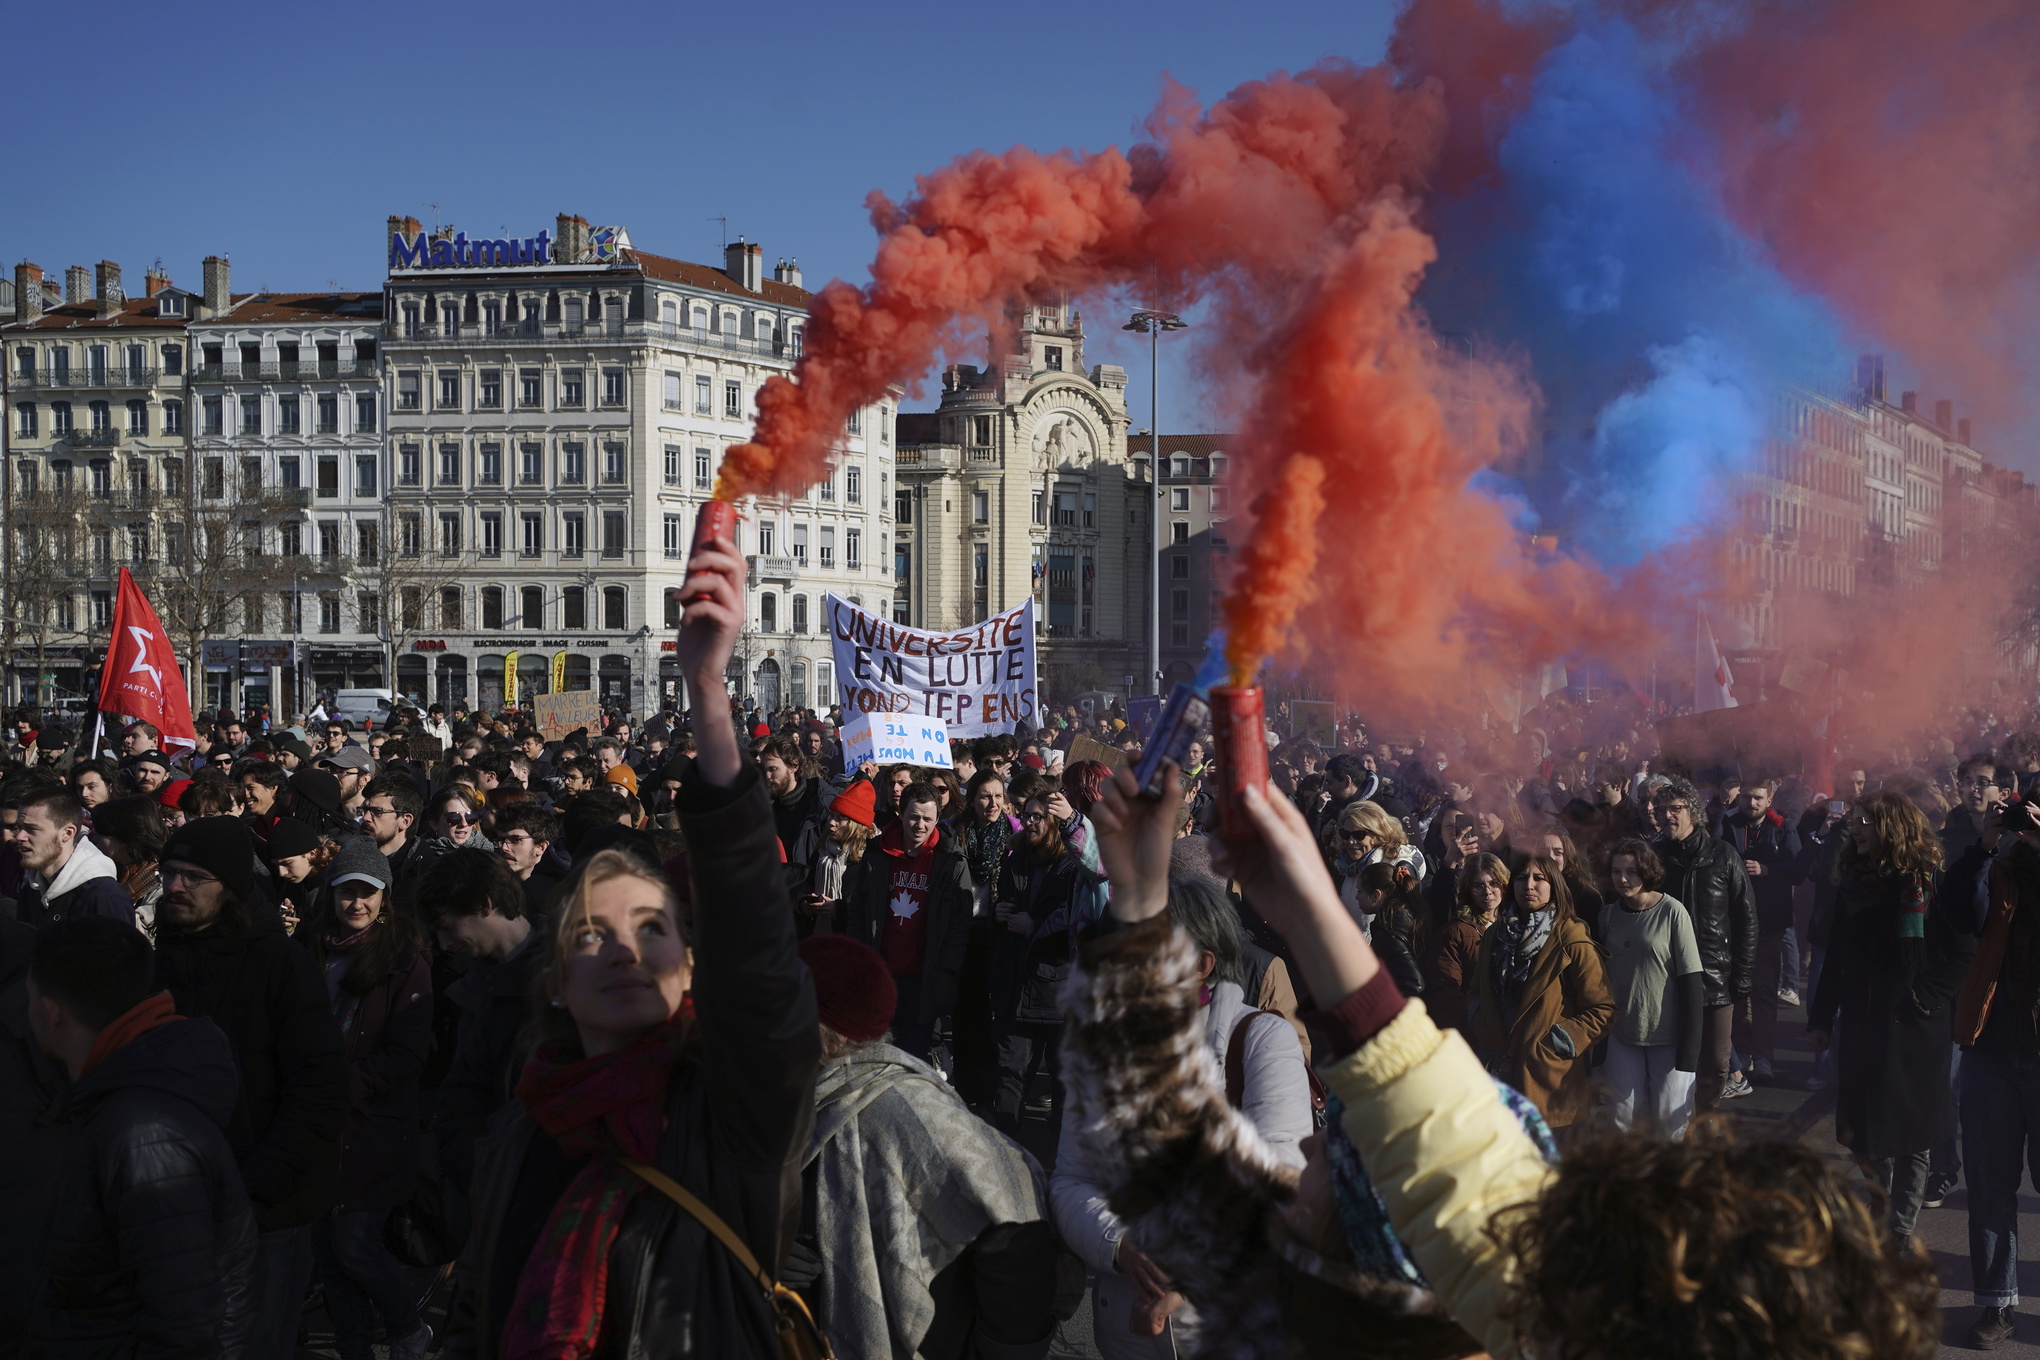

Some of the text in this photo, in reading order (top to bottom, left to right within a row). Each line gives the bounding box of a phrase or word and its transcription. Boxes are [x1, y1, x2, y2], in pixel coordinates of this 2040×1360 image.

[390, 229, 554, 268] Matmut
[834, 603, 1024, 656] UNIVERSITE
[415, 640, 447, 650] MDA
[660, 641, 677, 652] MD
[854, 646, 1024, 687] EN LUTTE
[123, 682, 148, 694] PARTI
[537, 692, 582, 712] MARRE
[585, 691, 599, 705] DE
[982, 689, 1035, 724] ENS
[885, 724, 908, 737] TE
[921, 728, 945, 744] ON
[845, 747, 950, 772] TU NOUS METS
